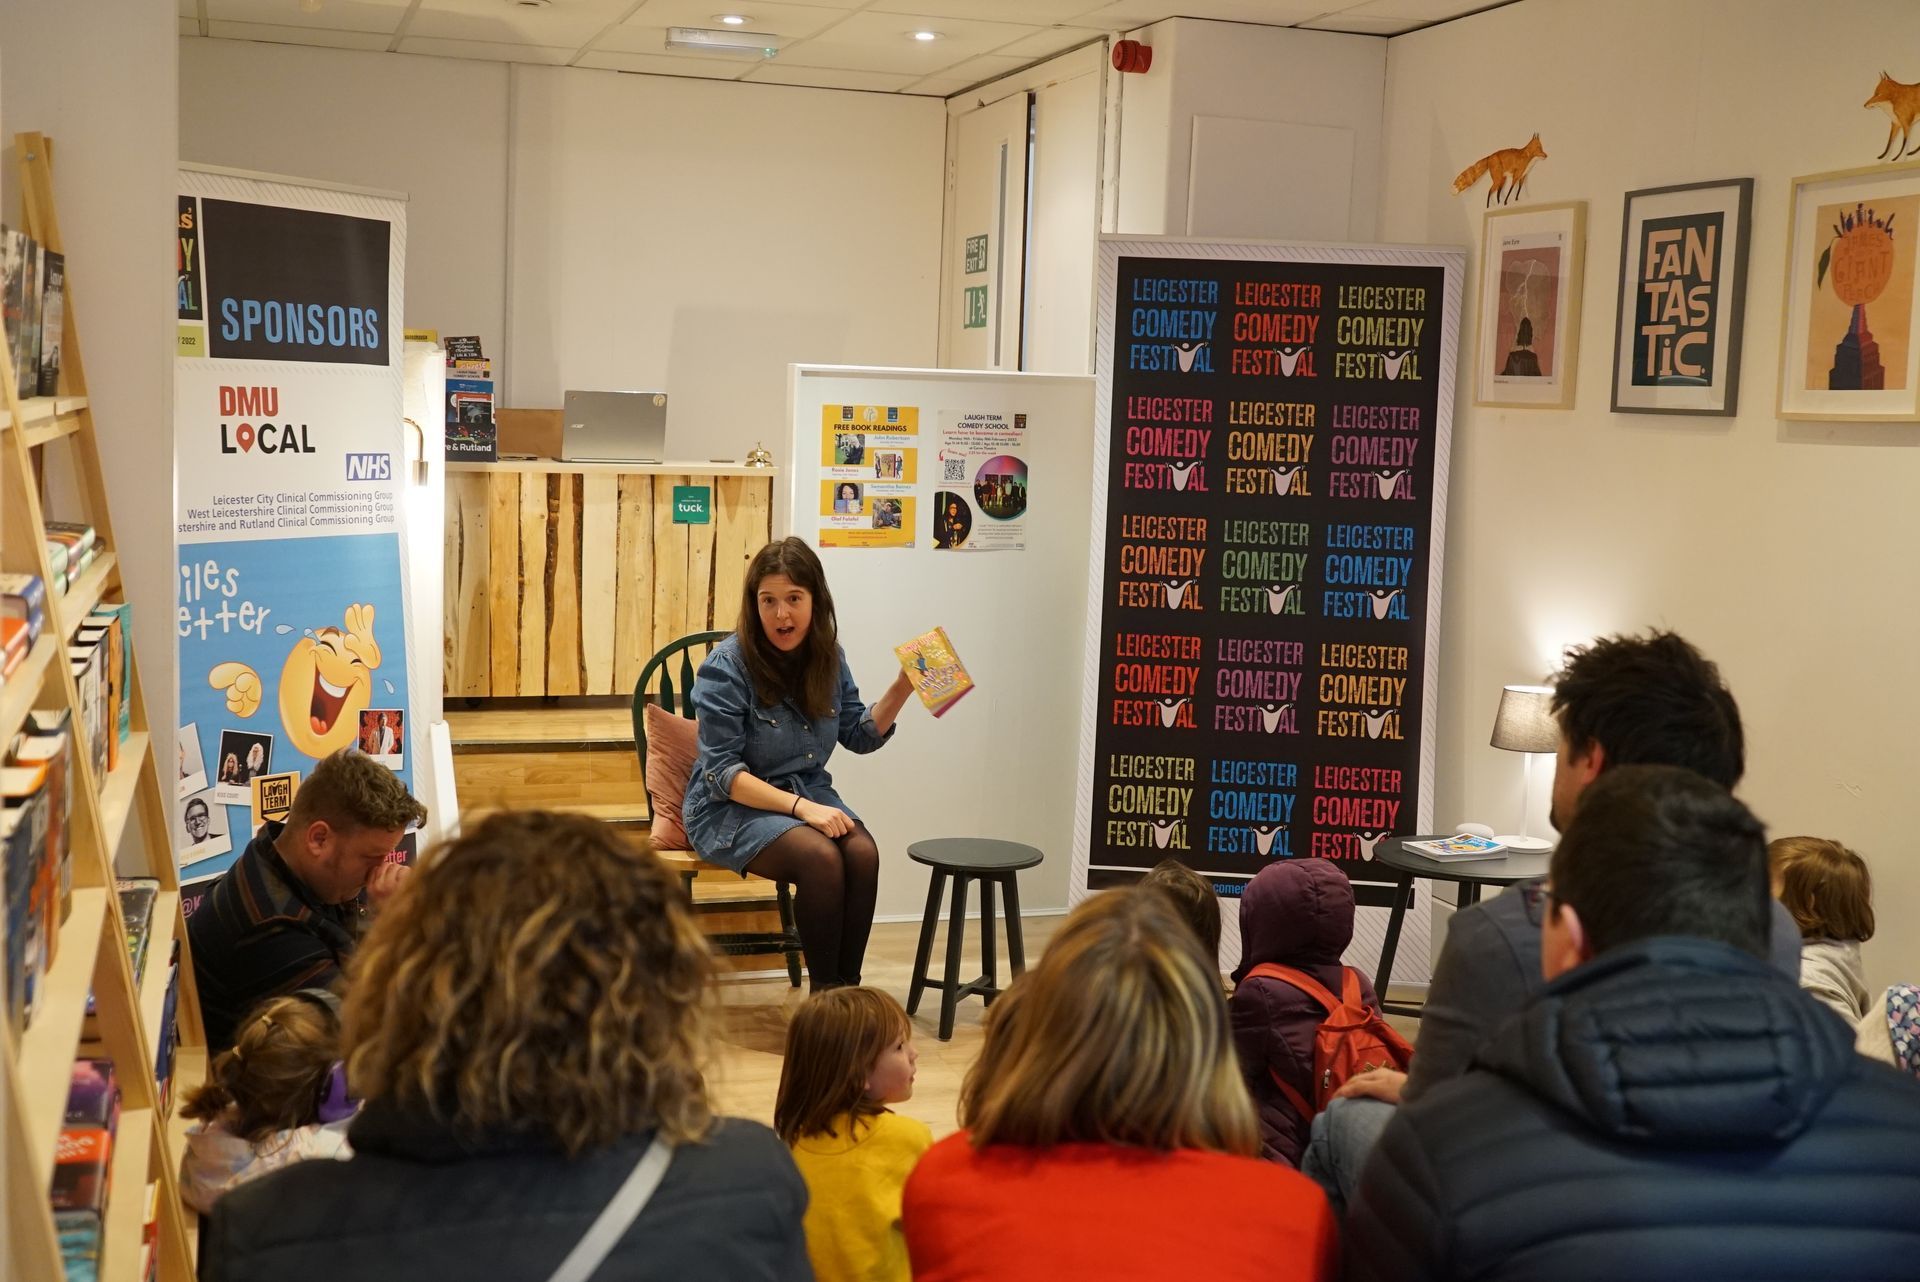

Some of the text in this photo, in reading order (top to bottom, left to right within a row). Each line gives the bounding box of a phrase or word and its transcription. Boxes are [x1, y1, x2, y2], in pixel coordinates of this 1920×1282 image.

[967, 240, 979, 254] FIRE
[1645, 225, 1716, 282] FAN
[966, 257, 978, 272] EXIT
[1834, 251, 1890, 284] GIANT
[1134, 279, 1217, 303] LEICESTER
[1236, 282, 1321, 307] LEICESTER
[1339, 286, 1425, 310] LEICESTER
[1644, 279, 1712, 327] TAS
[221, 297, 379, 350] SPONSORS
[1133, 308, 1216, 339] COMEDY
[1234, 312, 1319, 343] COMEDY
[1338, 316, 1424, 347] COMEDY
[181, 337, 196, 346] 2022
[1131, 343, 1214, 372] FESTIVAL
[1232, 347, 1317, 377] FESTIVAL
[1336, 350, 1421, 380] FESTIVAL
[219, 386, 279, 417] DMU
[1128, 396, 1212, 422] LEICESTER
[1230, 401, 1315, 427] LEICESTER
[834, 423, 850, 431] FREE
[873, 424, 907, 432] READINGS
[1333, 405, 1419, 430] LEICESTER
[220, 422, 316, 455] LOCAL
[459, 443, 492, 452] Rutland
[1126, 426, 1211, 458] COMEDY
[1228, 431, 1313, 462] COMEDY
[1332, 435, 1418, 466] COMEDY
[347, 454, 391, 480] NHS
[1125, 461, 1209, 491] FESTIVAL
[1226, 466, 1311, 496] FESTIVAL
[212, 490, 393, 506] Leicester City Clinical Commissioning Group
[1330, 470, 1416, 500] FESTIVAL
[178, 513, 395, 533] stershire and Rutland Clinical Commissioning Group
[187, 502, 394, 519] West Leicestershire Clinical Commissioning Group
[1122, 515, 1207, 541] LEICESTER
[1224, 520, 1308, 545] LEICESTER
[1327, 525, 1413, 550] LEICESTER
[1121, 545, 1205, 576] COMEDY
[1223, 550, 1307, 581] COMEDY
[1326, 555, 1412, 586] COMEDY
[1119, 580, 1203, 610] FESTIVAL
[1221, 585, 1305, 614] FESTIVAL
[1324, 589, 1409, 620] FESTIVAL
[179, 600, 271, 640] etter
[1117, 633, 1201, 660] LEICESTER
[1218, 639, 1303, 664] LEICESTER
[1321, 644, 1408, 670] LEICESTER
[1115, 663, 1199, 695] COMEDY
[1217, 669, 1302, 700] COMEDY
[1320, 674, 1406, 706] COMEDY
[1113, 698, 1197, 728] FESTIVAL
[1215, 704, 1299, 734] FESTIVAL
[1318, 709, 1404, 739] FESTIVAL
[1111, 755, 1194, 780] LEICESTER
[1212, 760, 1296, 786] LEICESTER
[1315, 766, 1401, 793] LEICESTER
[265, 796, 288, 809] TERM
[1109, 784, 1193, 816] COMEDY
[1211, 790, 1295, 822] COMEDY
[1313, 796, 1400, 829] COMEDY
[1107, 819, 1190, 849] FESTIVAL
[1209, 825, 1293, 855] FESTIVAL
